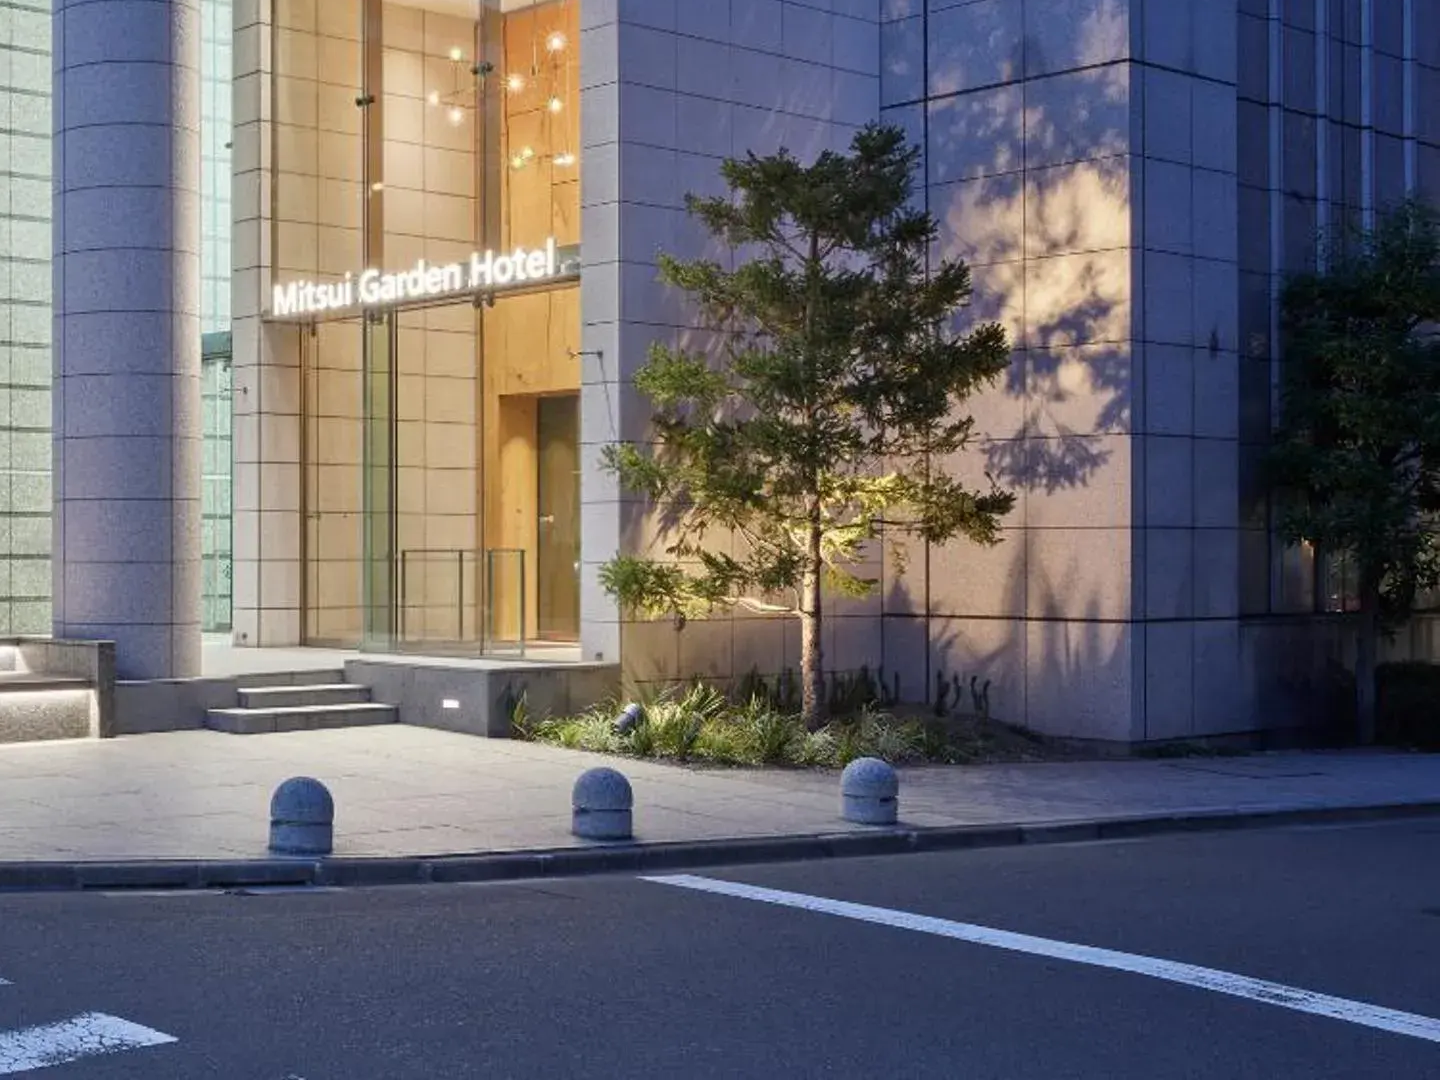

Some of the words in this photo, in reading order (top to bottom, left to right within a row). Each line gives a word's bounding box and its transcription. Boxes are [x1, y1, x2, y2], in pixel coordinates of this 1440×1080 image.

[273, 272, 351, 316] Mitsui
[360, 259, 461, 303] Garden
[470, 238, 556, 286] Hotel
